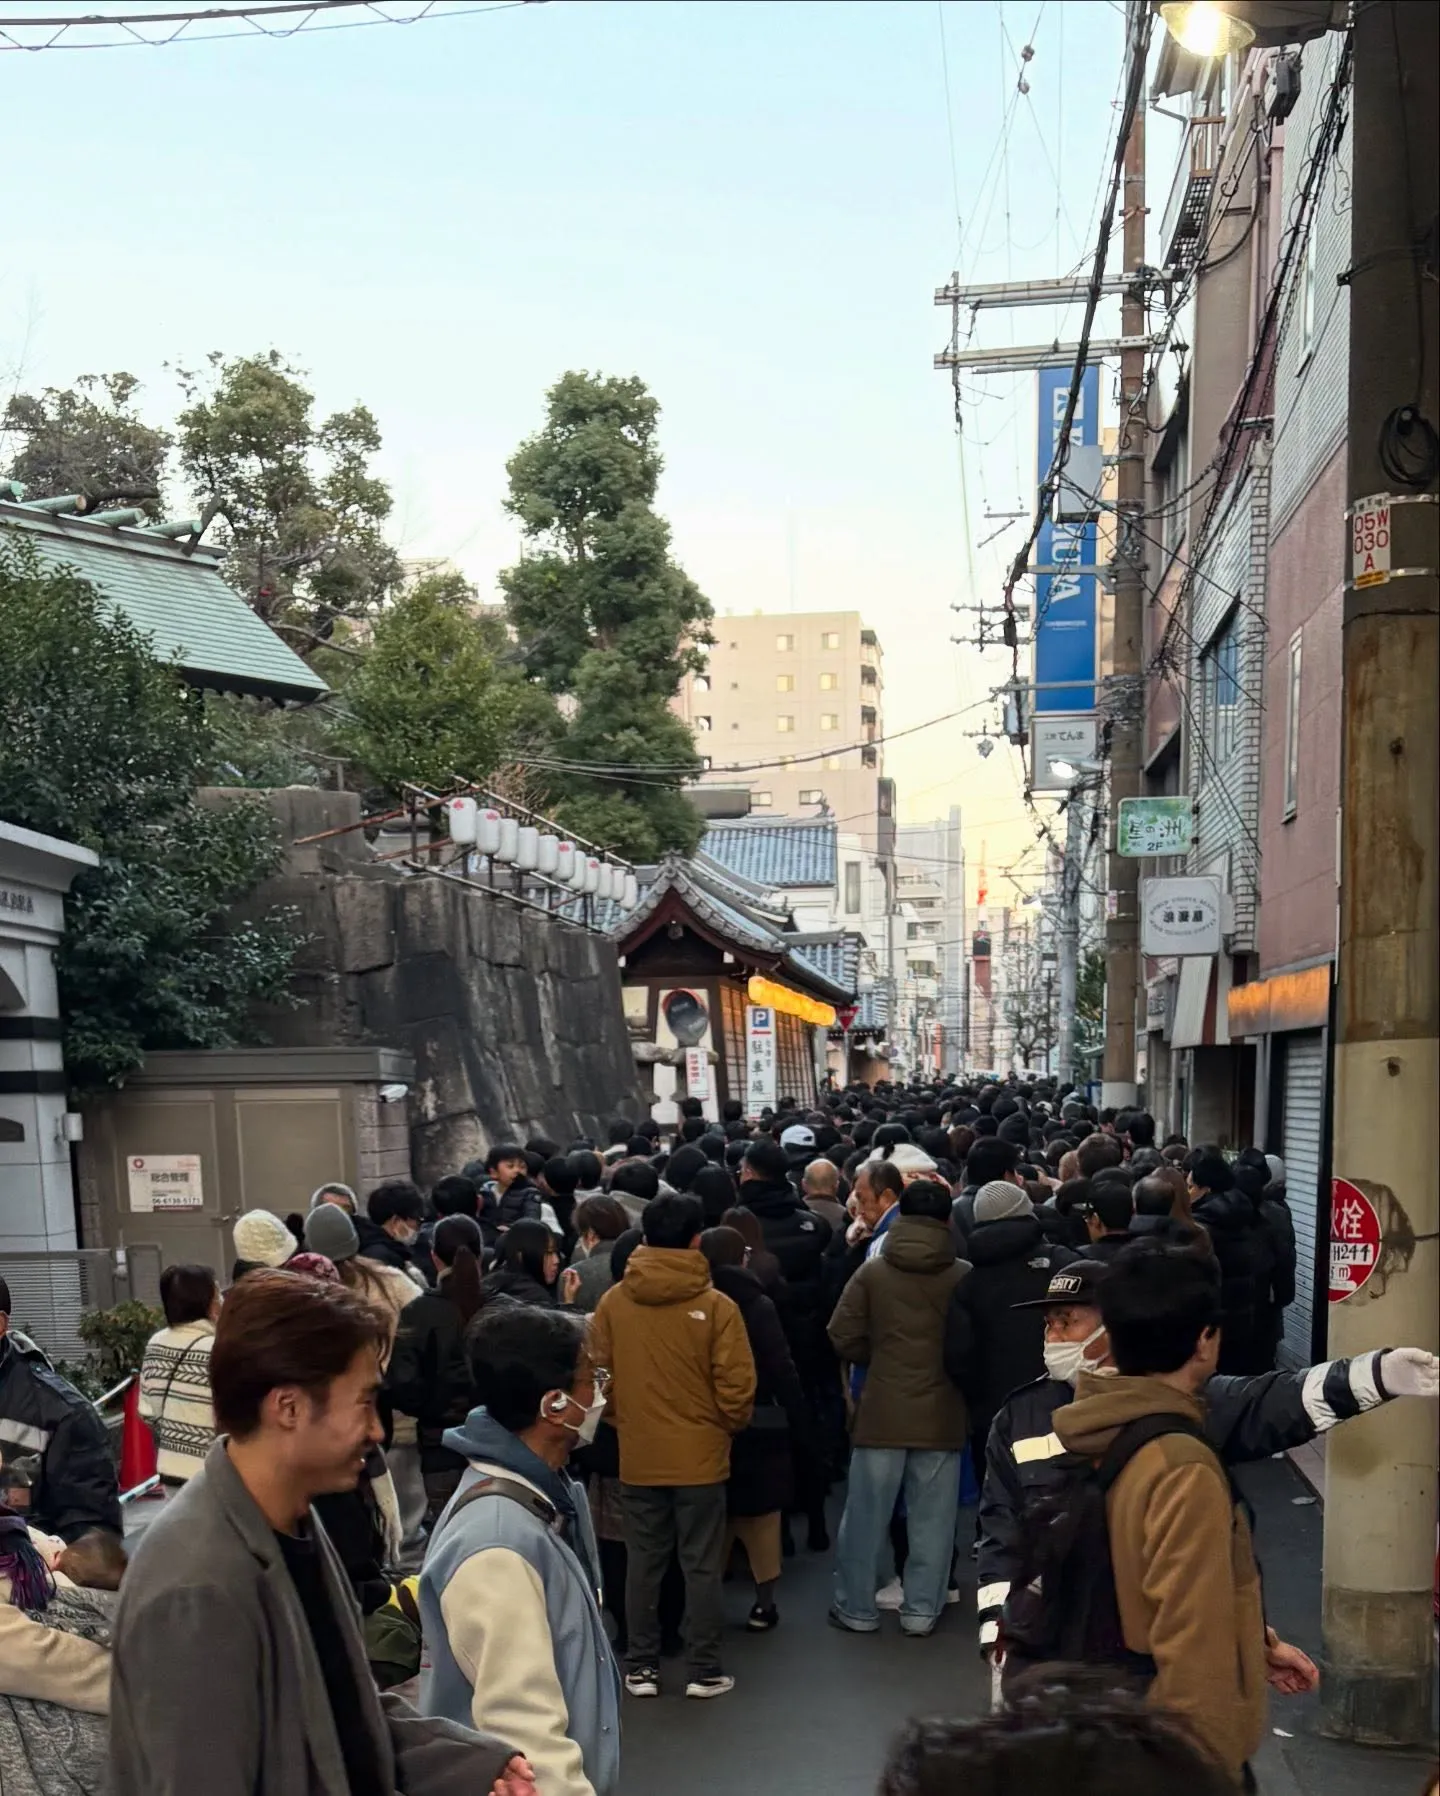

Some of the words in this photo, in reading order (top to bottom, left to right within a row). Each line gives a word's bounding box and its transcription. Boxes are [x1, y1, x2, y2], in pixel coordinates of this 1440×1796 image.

[1354, 509, 1388, 534] 05W
[1354, 530, 1388, 554] 030
[1364, 553, 1375, 571] A
[1147, 842, 1163, 852] 2F
[755, 1011, 767, 1025] P
